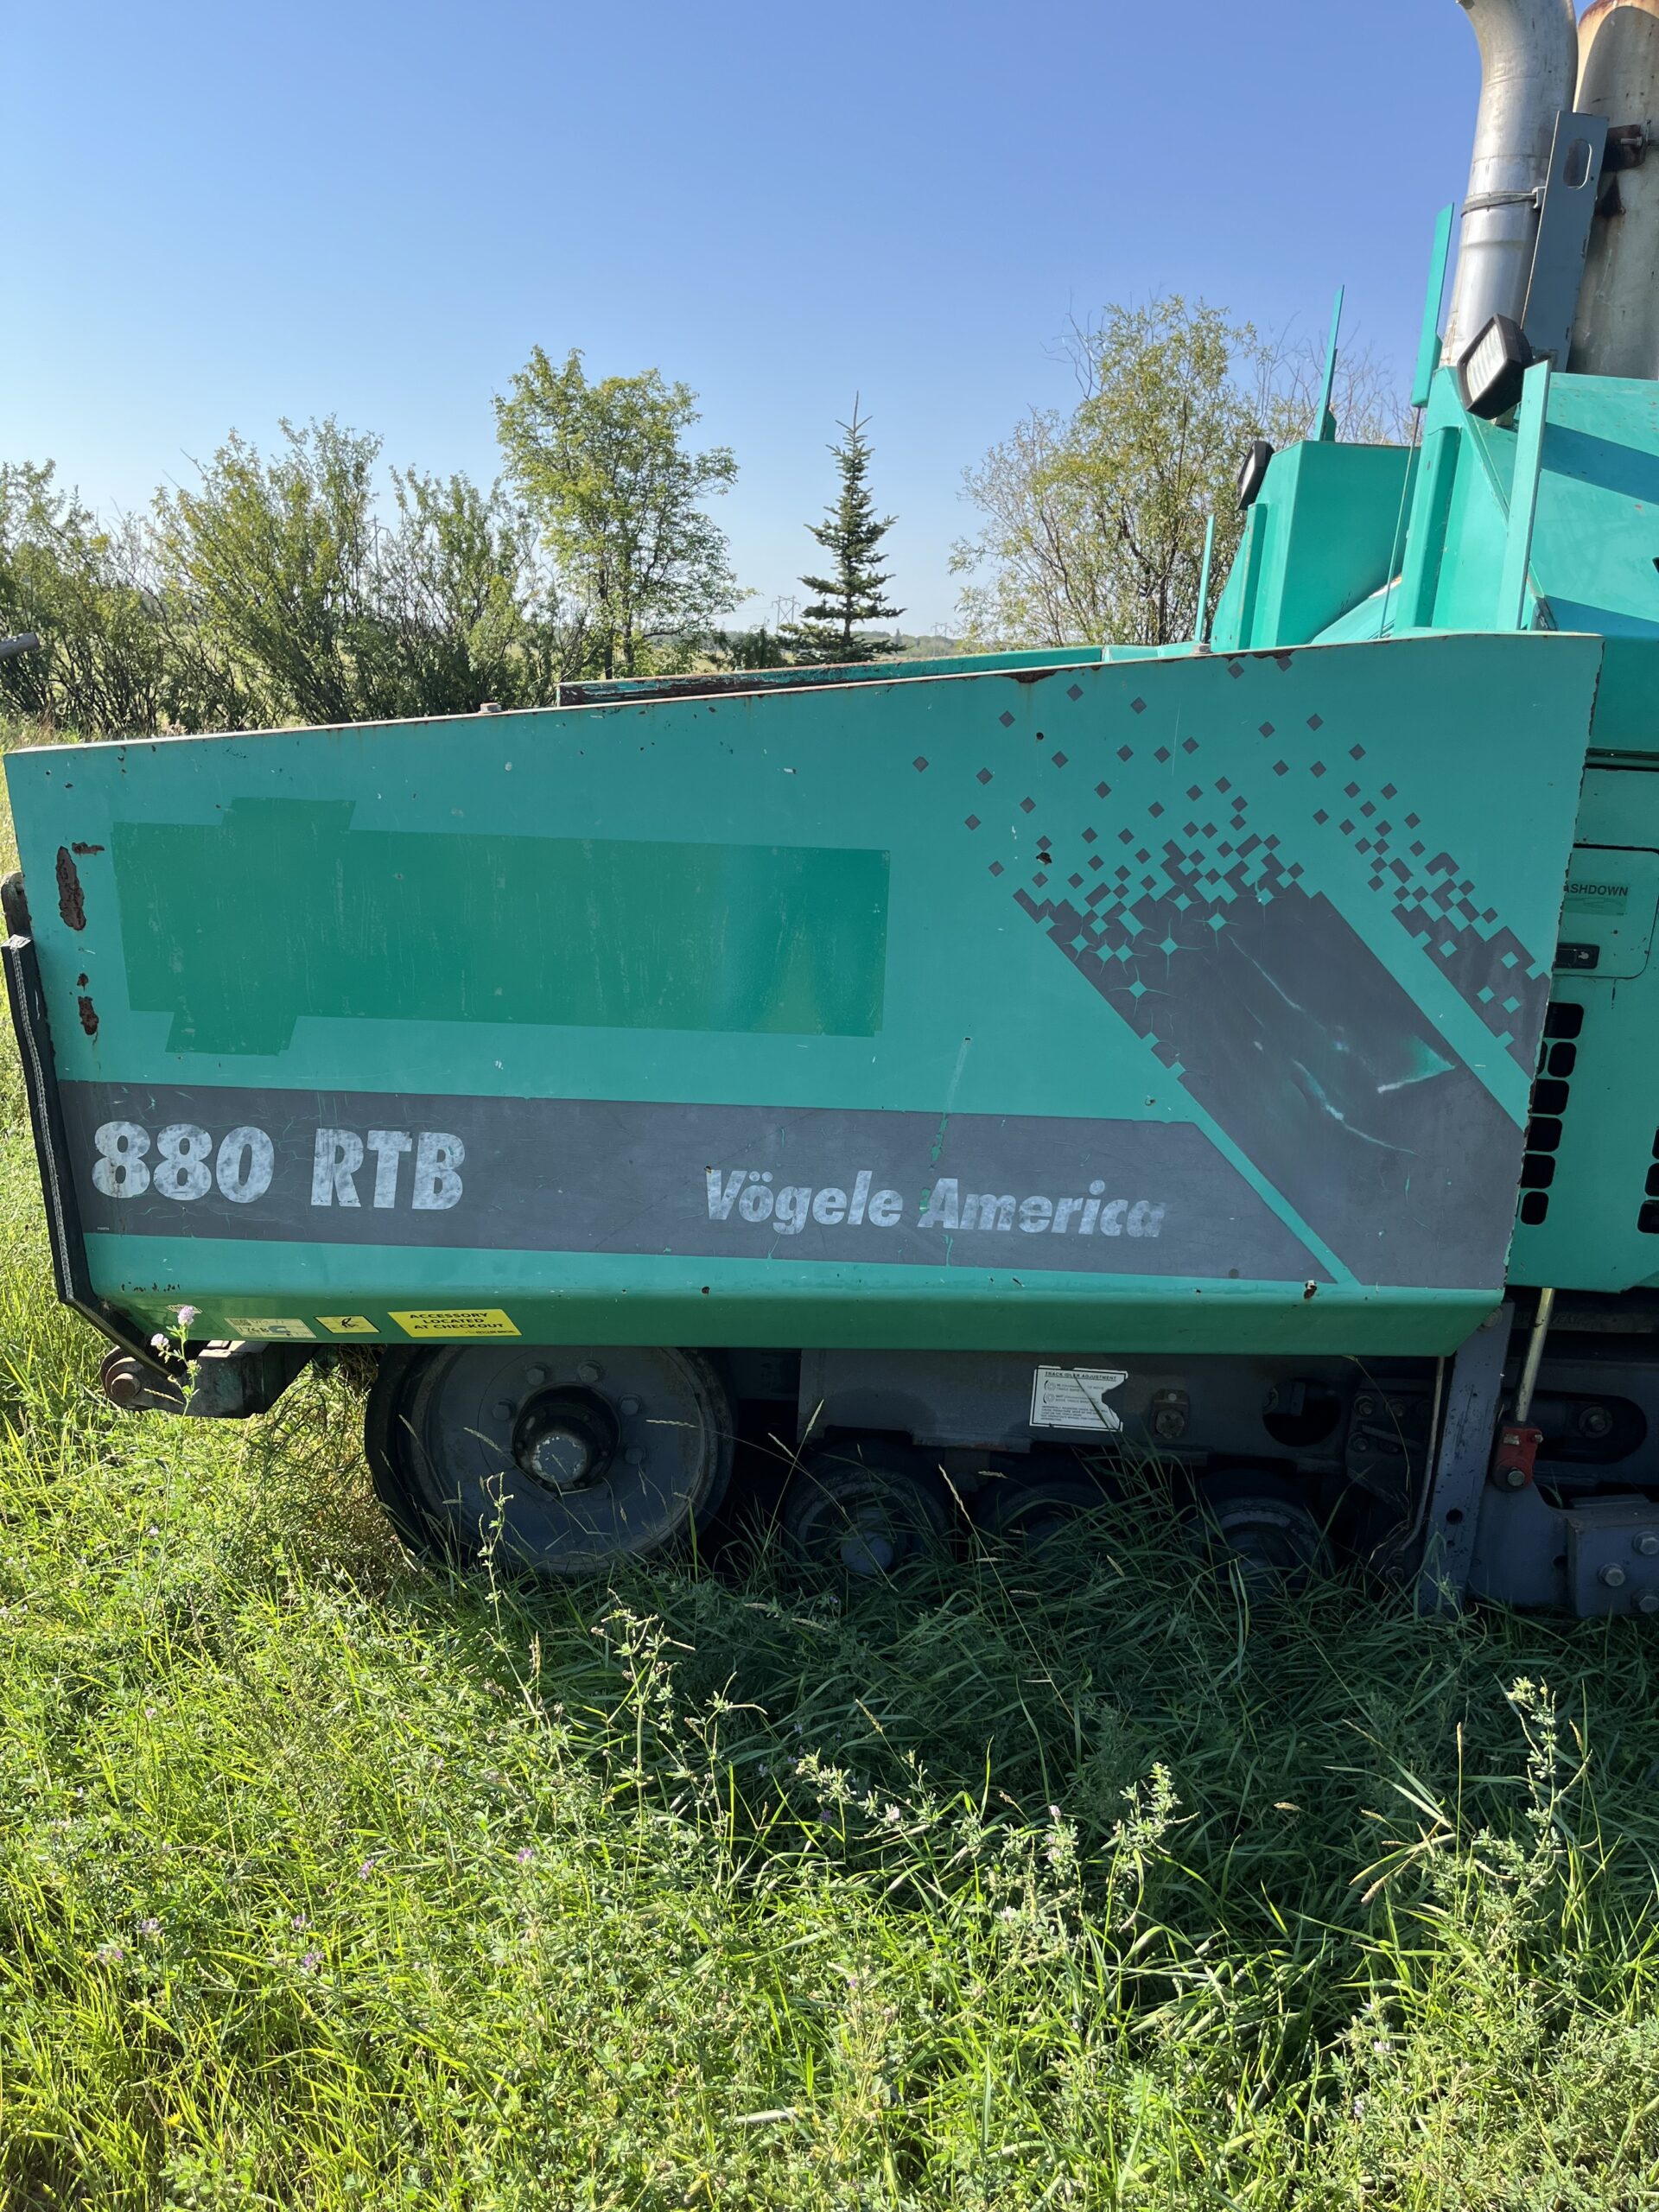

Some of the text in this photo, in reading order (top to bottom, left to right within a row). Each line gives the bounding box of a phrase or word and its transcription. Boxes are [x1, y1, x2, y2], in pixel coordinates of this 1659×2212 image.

[92, 1121, 466, 1211] 880 RTB
[705, 1169, 1167, 1238] Vögele America
